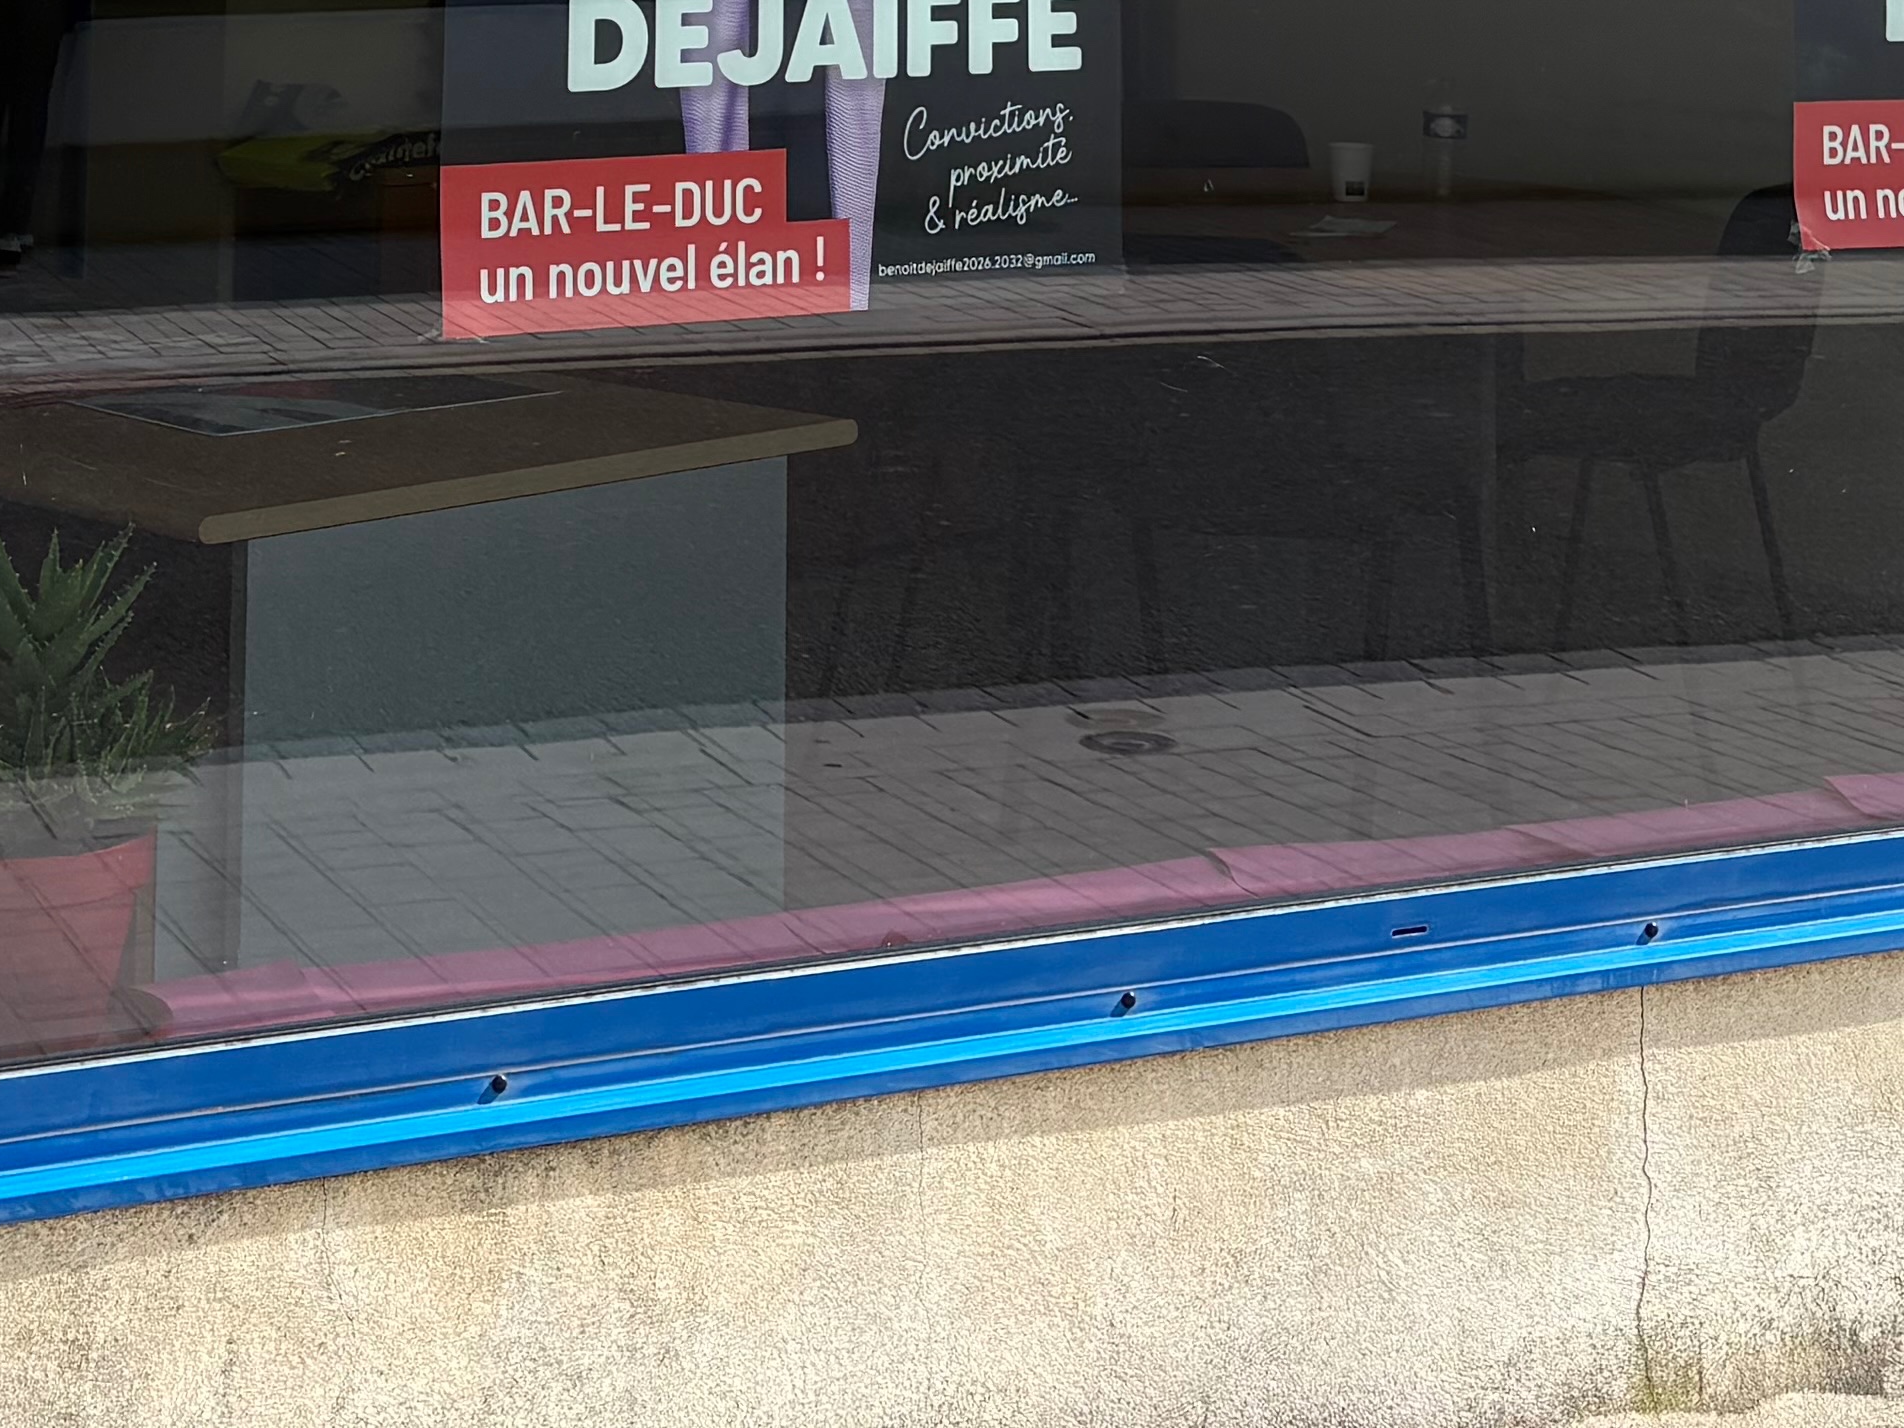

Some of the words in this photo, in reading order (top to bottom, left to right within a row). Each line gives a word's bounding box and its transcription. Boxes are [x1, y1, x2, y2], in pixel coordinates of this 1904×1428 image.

[948, 133, 1073, 208] proximité
[479, 176, 763, 239] BAR-LE-DUC
[924, 195, 946, 235] &
[1824, 188, 1868, 221] un
[479, 263, 534, 304] un
[549, 243, 697, 301] nouvel
[708, 241, 800, 289] élan
[816, 235, 827, 282] !
